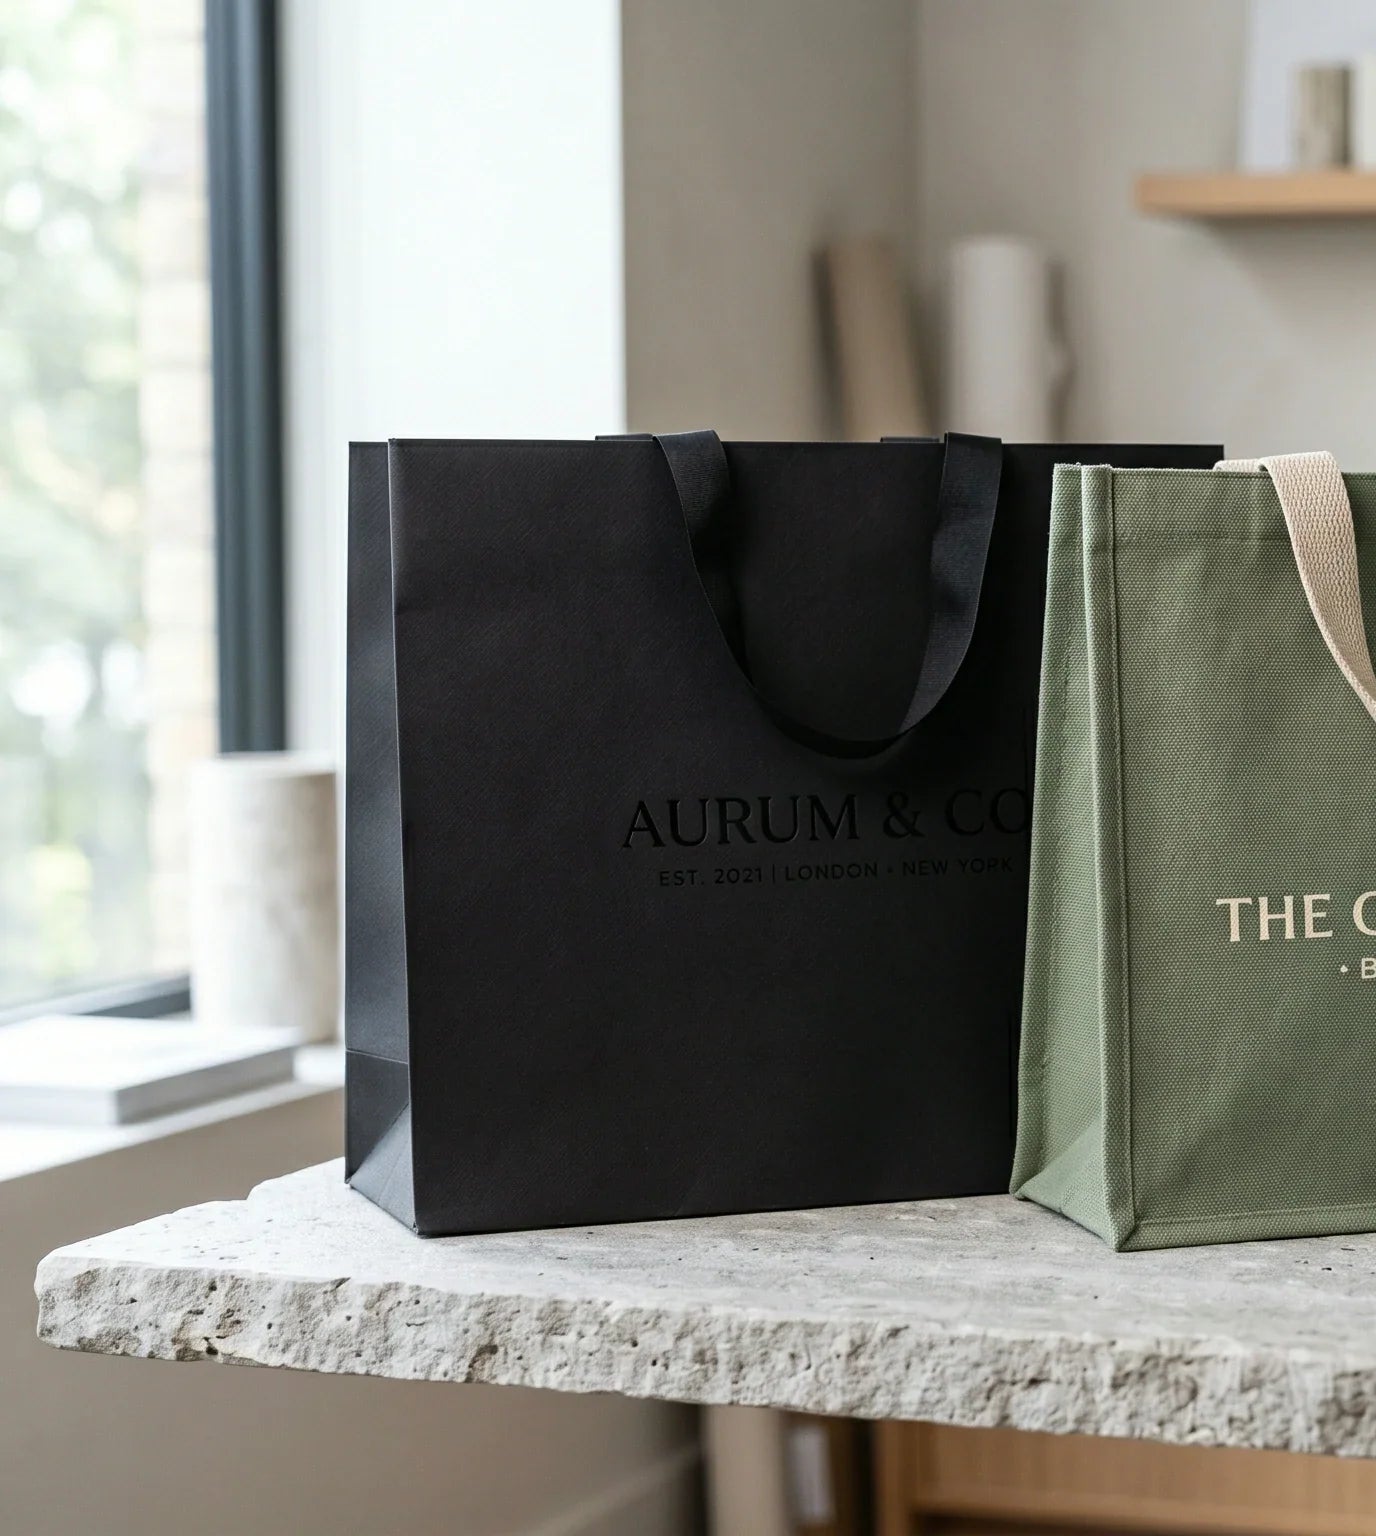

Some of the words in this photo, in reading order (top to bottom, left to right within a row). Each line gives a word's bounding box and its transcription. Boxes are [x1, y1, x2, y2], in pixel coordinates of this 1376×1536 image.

[622, 793, 861, 848] AURUM
[882, 790, 925, 838] &
[944, 787, 1030, 836] CO
[659, 870, 704, 886] EST.
[715, 867, 762, 884] 2021
[785, 862, 878, 881] LONDON
[903, 859, 949, 876] NEW
[958, 857, 1013, 873] YORK
[1216, 893, 1333, 942] THE
